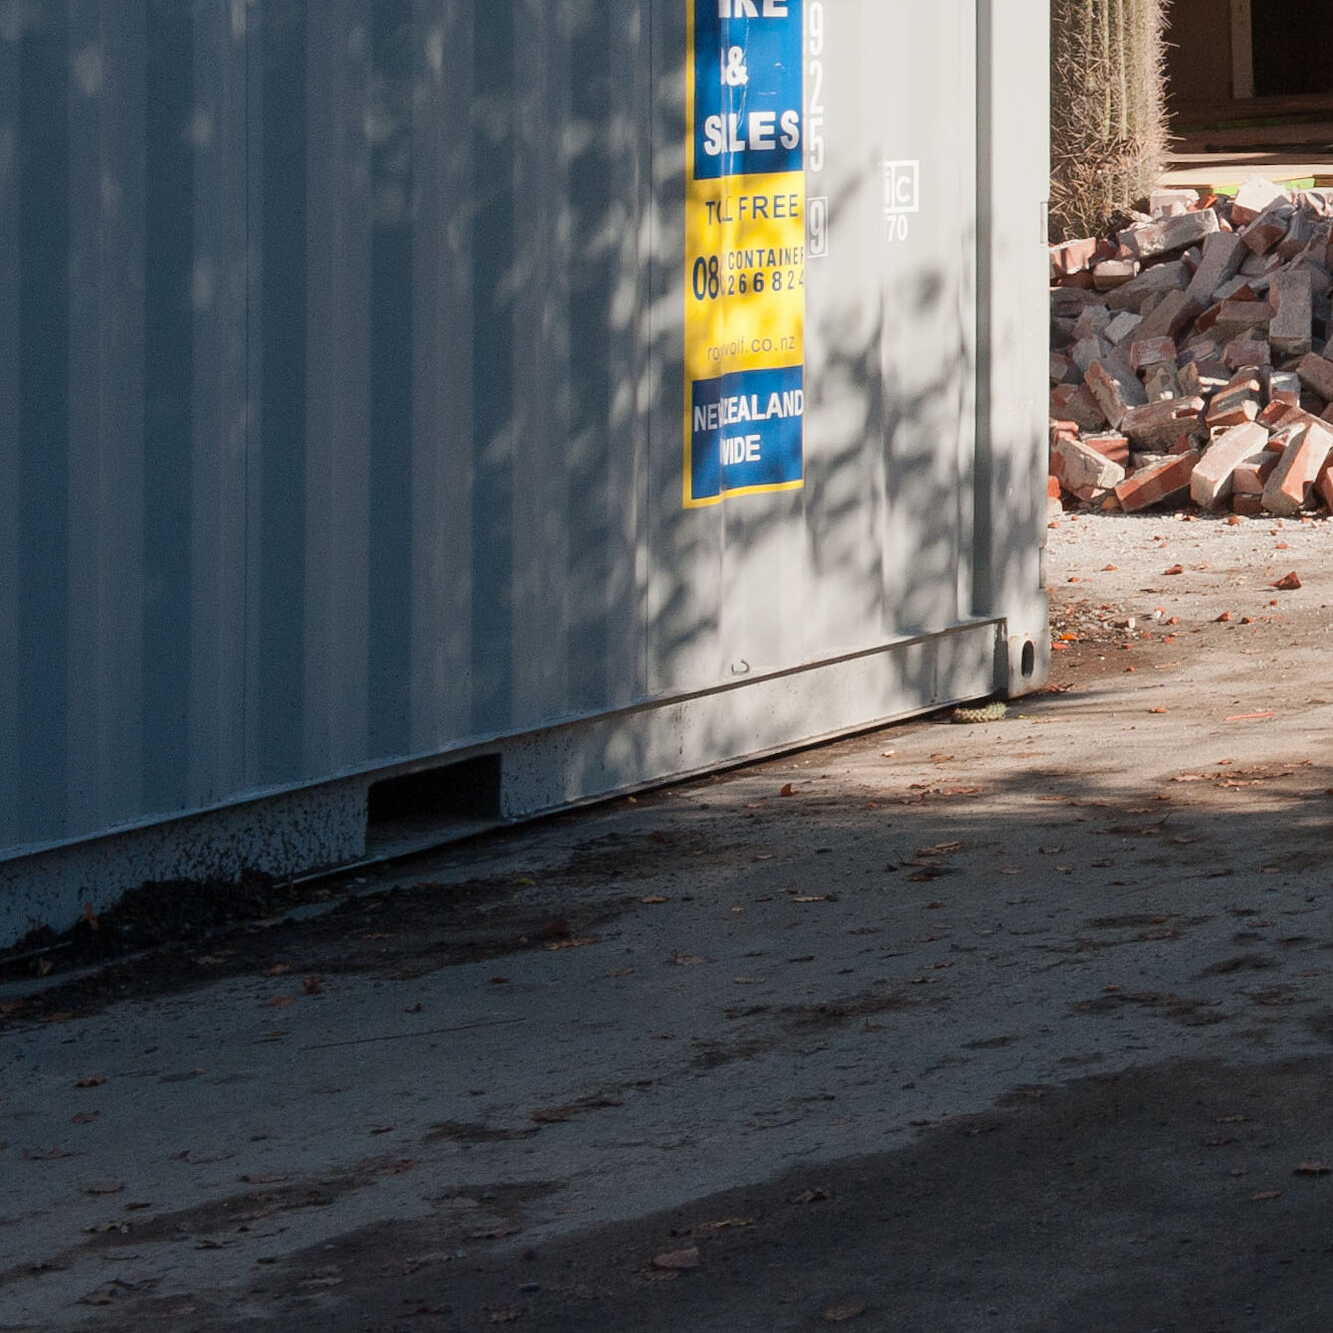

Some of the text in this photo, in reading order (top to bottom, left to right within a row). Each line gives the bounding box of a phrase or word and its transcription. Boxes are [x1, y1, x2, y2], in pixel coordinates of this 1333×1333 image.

[704, 109, 800, 156] SLES
[738, 193, 799, 222] FREE
[810, 199, 825, 255] 9
[886, 214, 908, 242] 70
